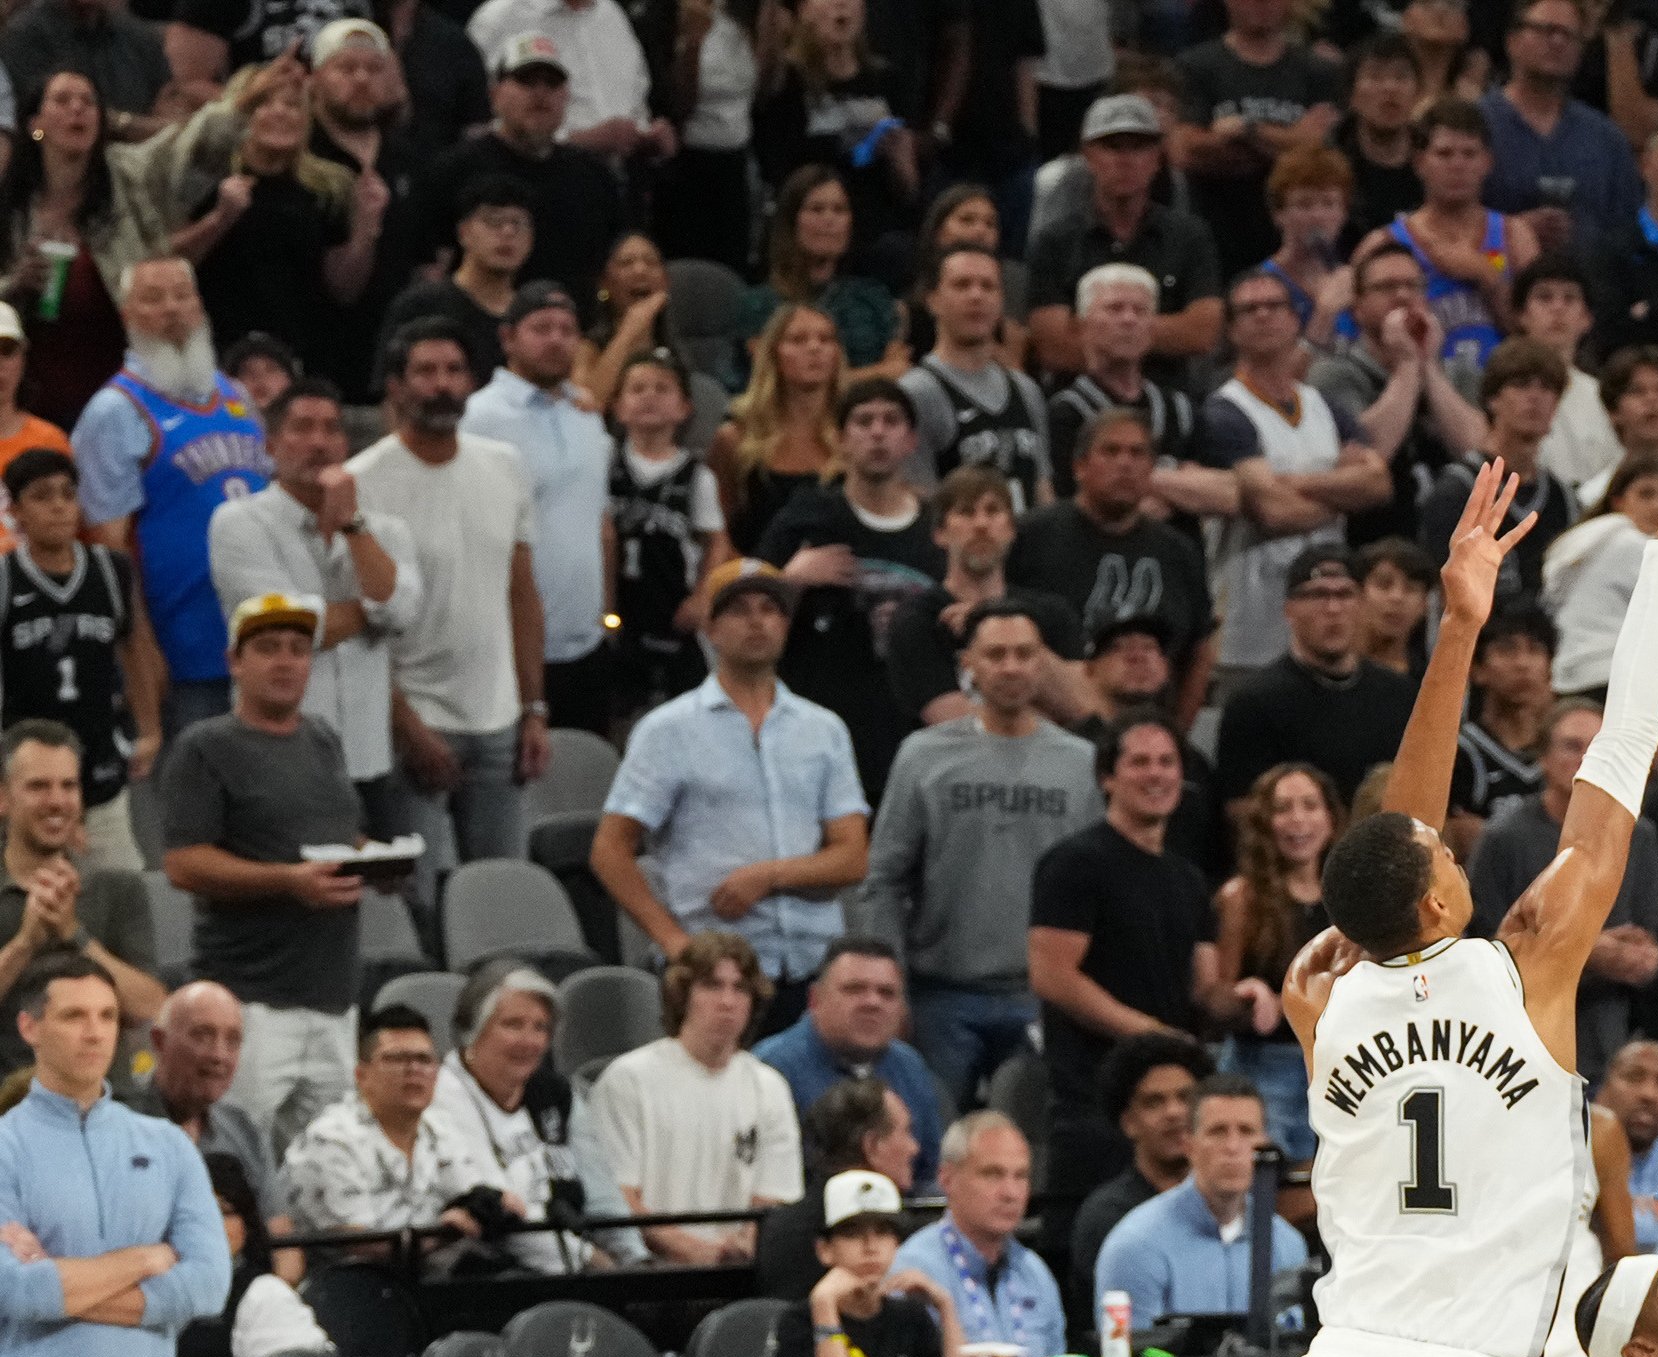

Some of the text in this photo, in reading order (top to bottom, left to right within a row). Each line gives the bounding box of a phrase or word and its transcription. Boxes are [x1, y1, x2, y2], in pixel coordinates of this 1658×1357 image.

[57, 656, 79, 701] 1
[950, 781, 1067, 818] SPURS
[1325, 1019, 1540, 1118] WEMBANYAMA
[1398, 1085, 1458, 1217] 1
